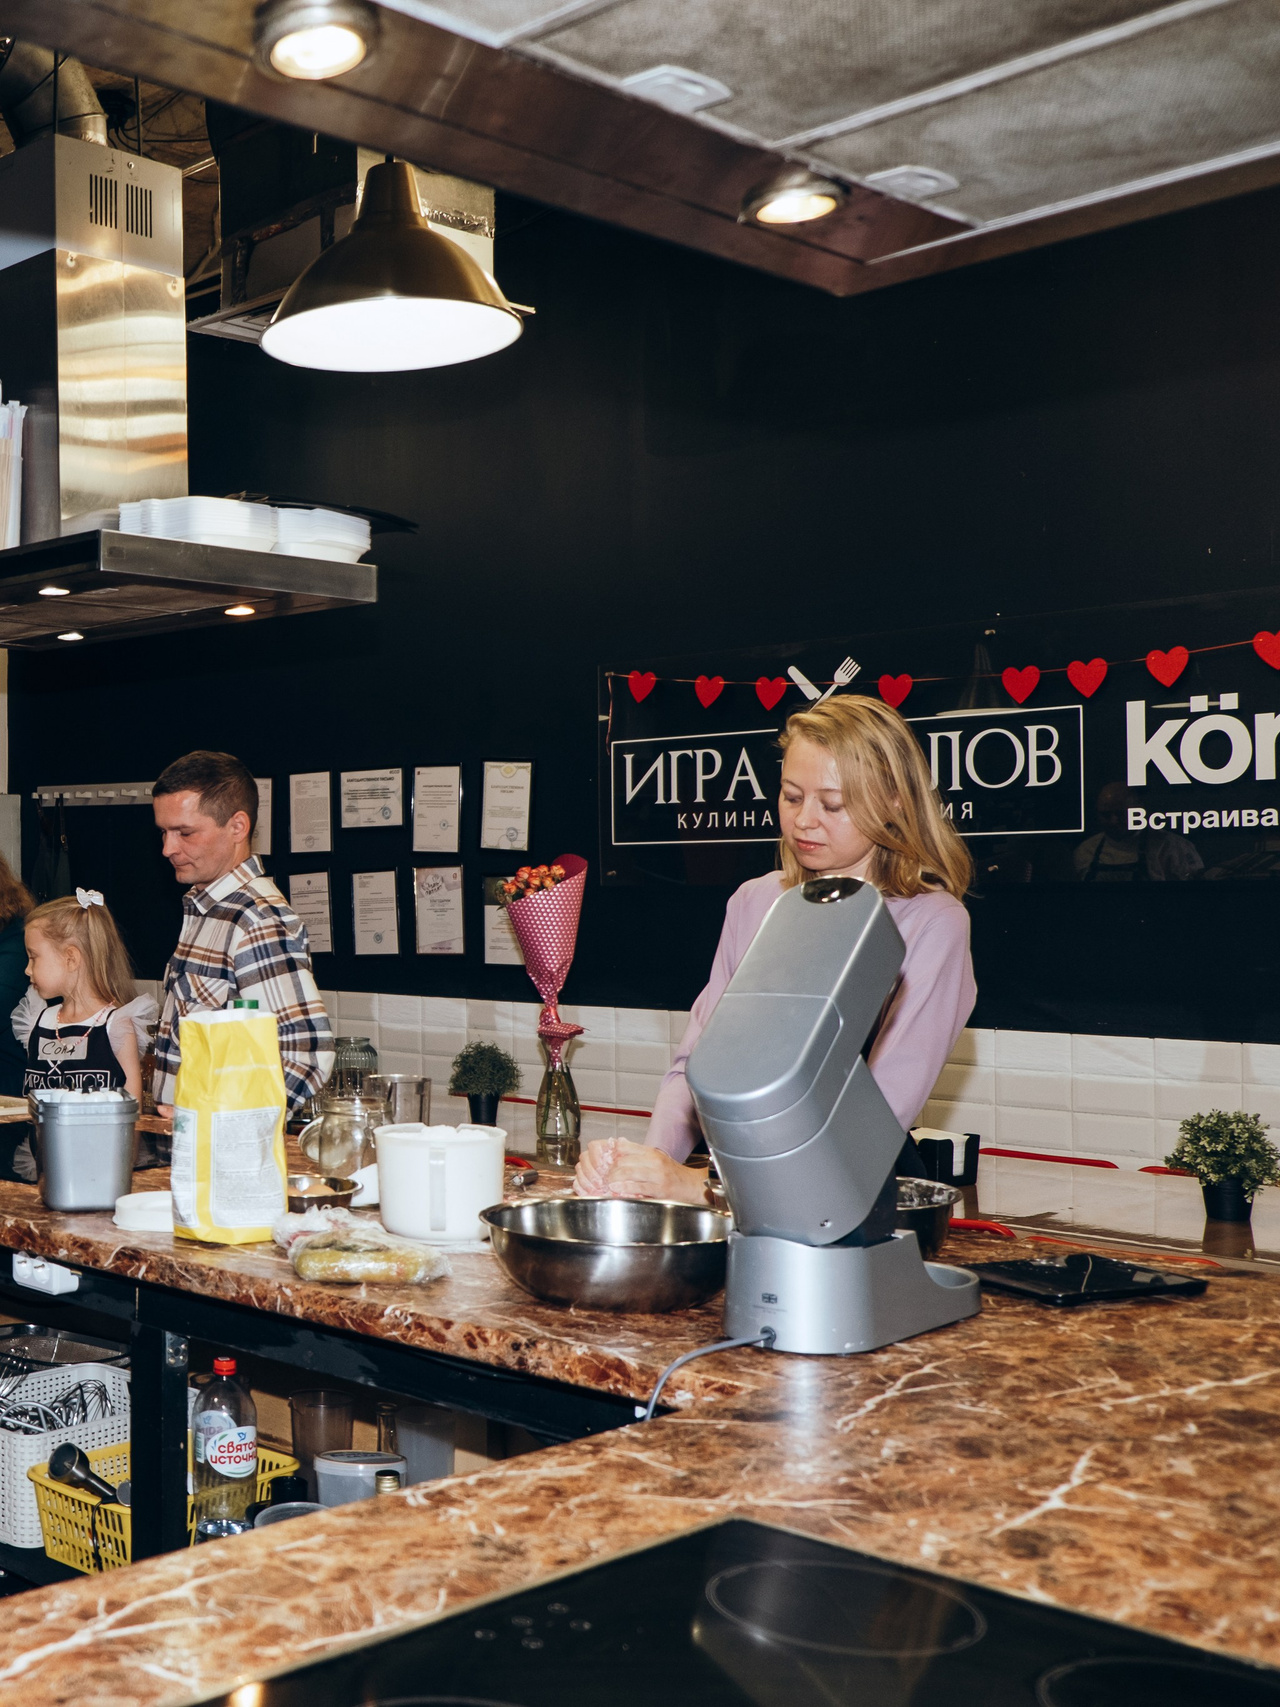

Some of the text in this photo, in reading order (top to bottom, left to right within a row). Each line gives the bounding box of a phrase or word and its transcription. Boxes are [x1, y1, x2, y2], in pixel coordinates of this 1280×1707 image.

[622, 724, 1063, 805] ИГРА ЛОВ
[677, 809, 774, 829] КУЛИНА
